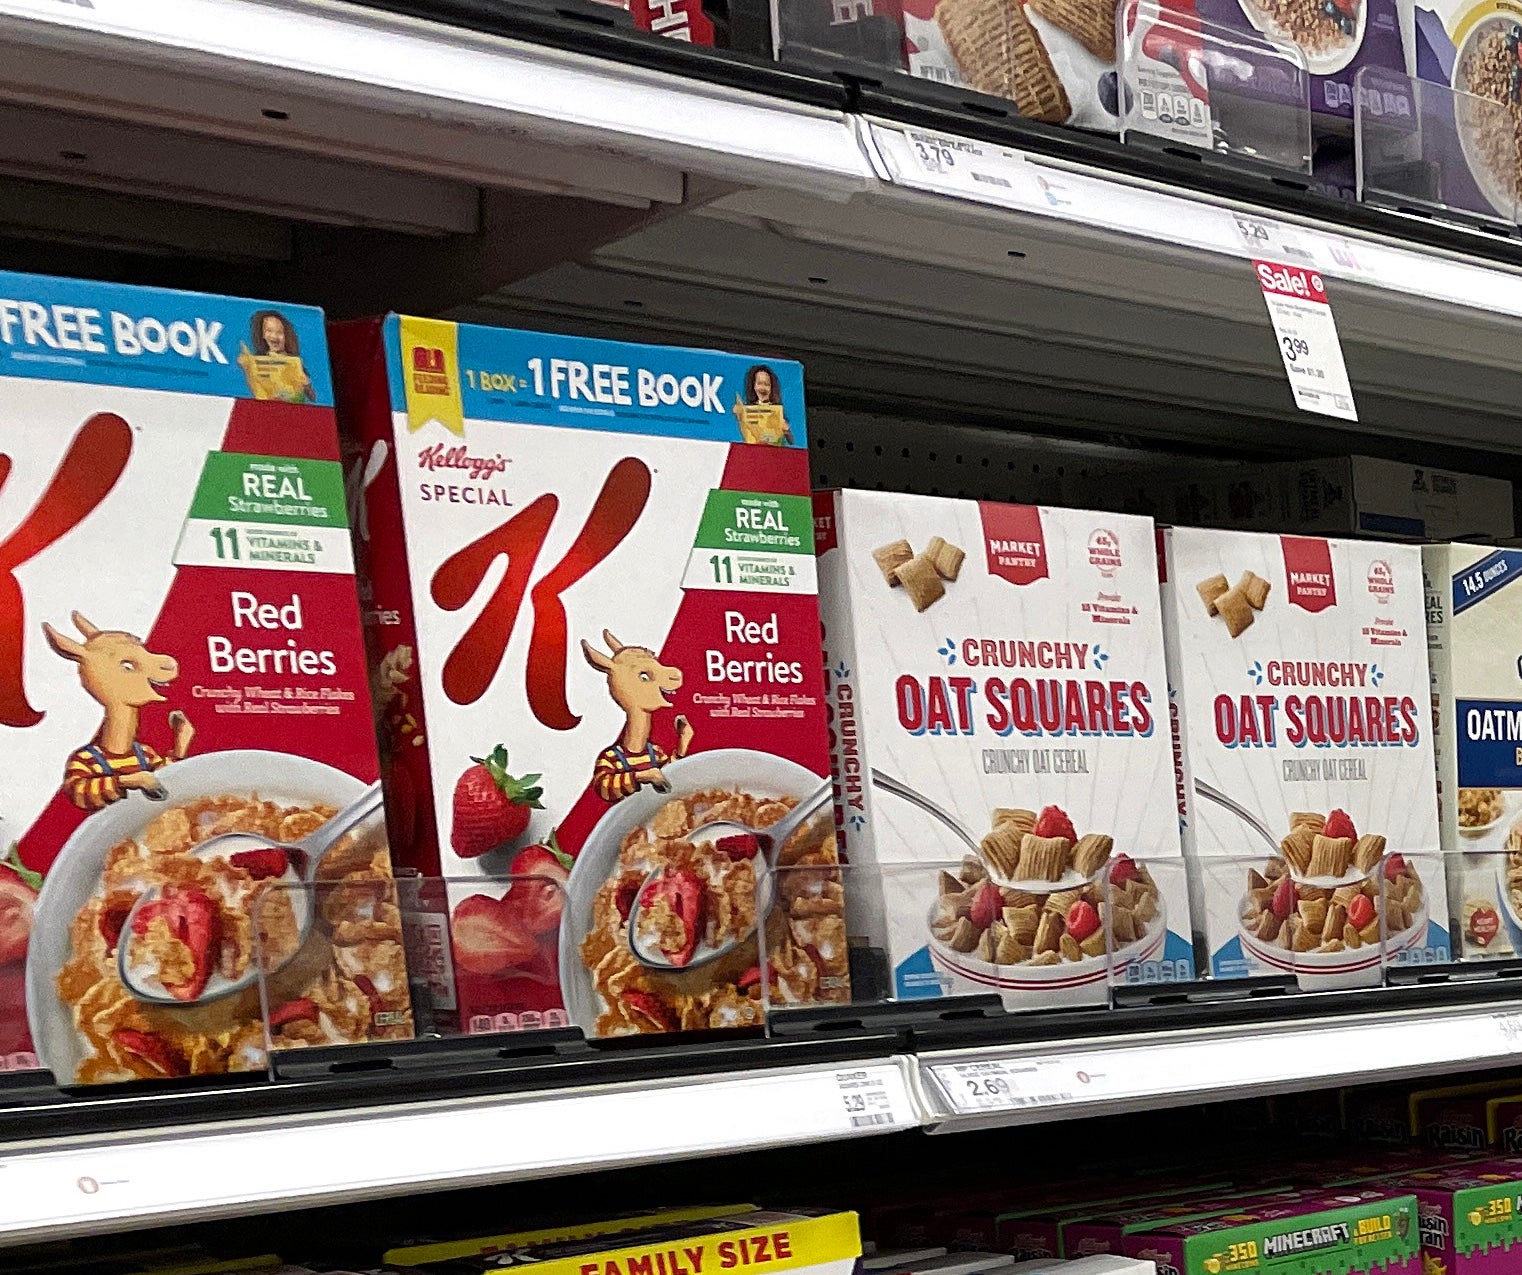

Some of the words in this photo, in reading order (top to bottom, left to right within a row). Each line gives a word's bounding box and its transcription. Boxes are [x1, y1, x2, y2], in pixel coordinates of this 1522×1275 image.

[1256, 263, 1311, 297] Sale!
[111, 311, 229, 365] BOOK
[638, 367, 726, 414] BOOK
[242, 474, 313, 502] REAL
[420, 484, 514, 508] SPECIAL
[736, 507, 790, 532] REAL
[209, 527, 241, 561] 11
[231, 591, 303, 630] Red
[725, 611, 779, 645] Red
[207, 636, 337, 676] Berries
[705, 650, 803, 685] Berries
[961, 637, 1090, 670] CRUNCHY
[1266, 660, 1368, 688] CRUNCHY
[895, 674, 978, 738] OAT
[984, 676, 1156, 738] SQUARES
[1213, 693, 1279, 750] OAT
[1285, 694, 1420, 749] SQUARES
[836, 683, 864, 812] CRUNCHY
[719, 1231, 793, 1270] SIZE
[1263, 1222, 1350, 1258] MINECRAFT
